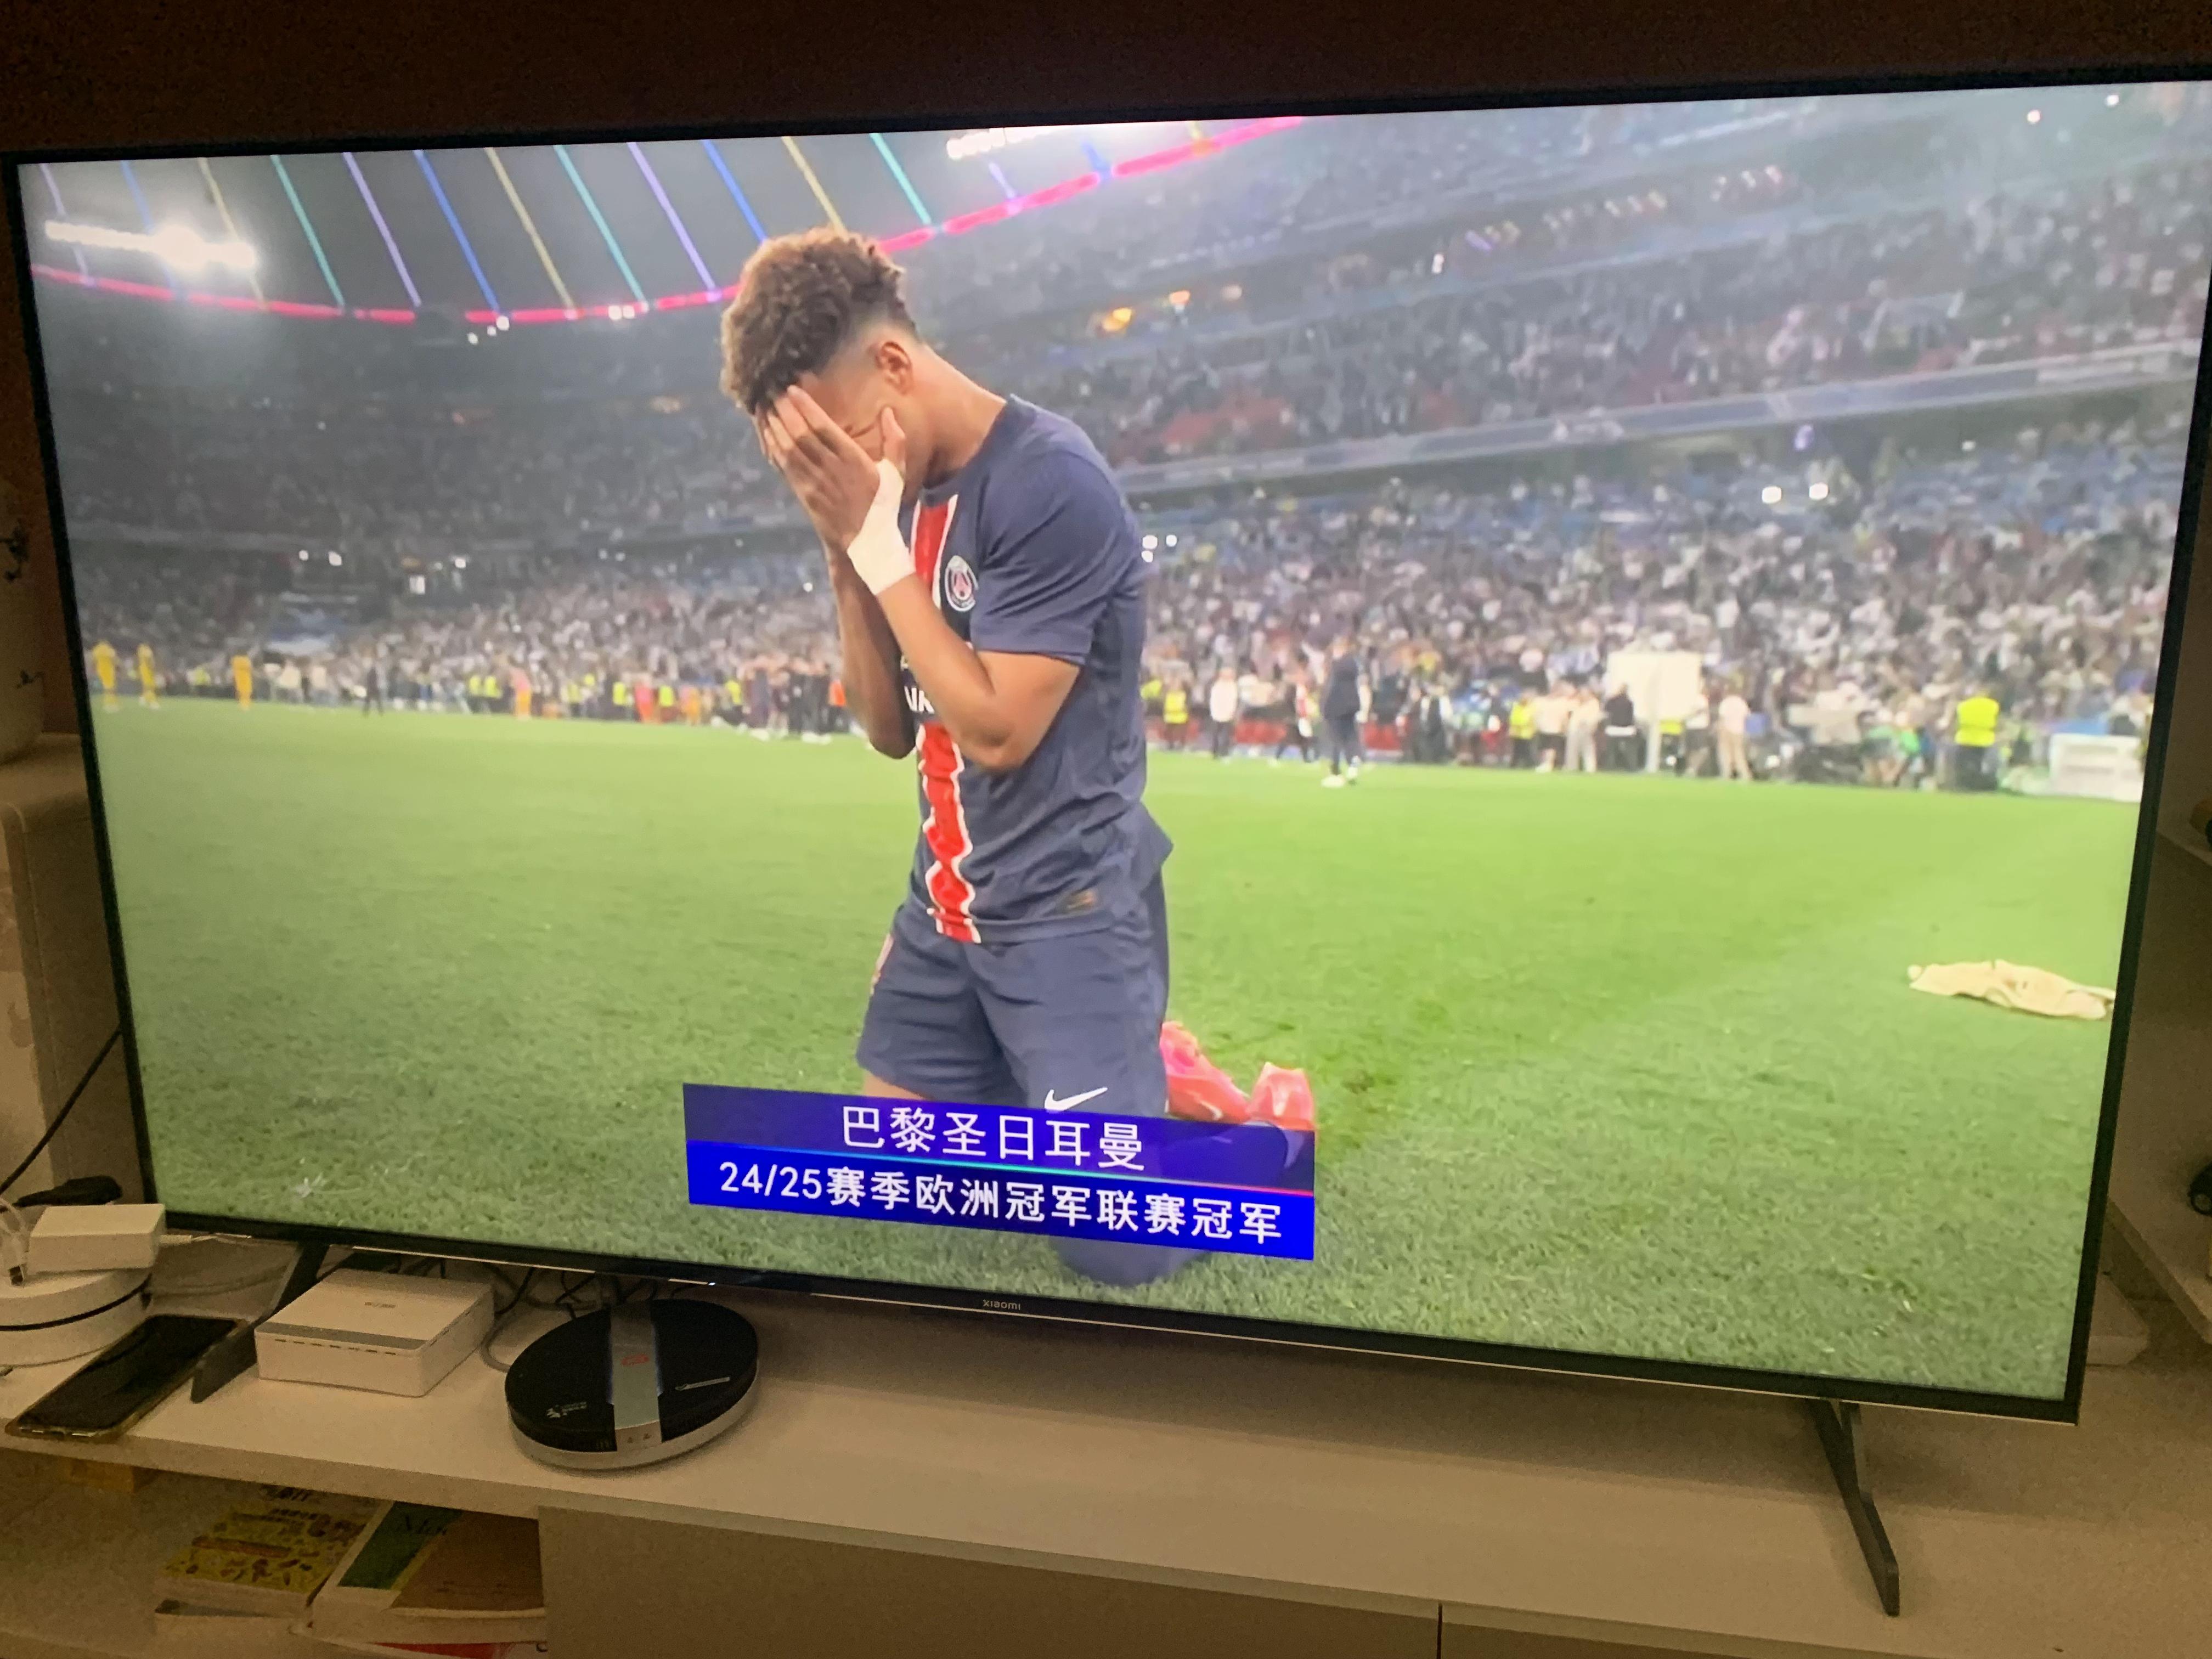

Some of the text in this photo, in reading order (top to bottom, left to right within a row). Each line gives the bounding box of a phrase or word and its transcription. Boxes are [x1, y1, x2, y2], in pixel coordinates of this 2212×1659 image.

[842, 1104, 1146, 1172] 巴黎圣日耳曼
[719, 1160, 1283, 1245] 24/25赛季欧洲冠军联赛冠军
